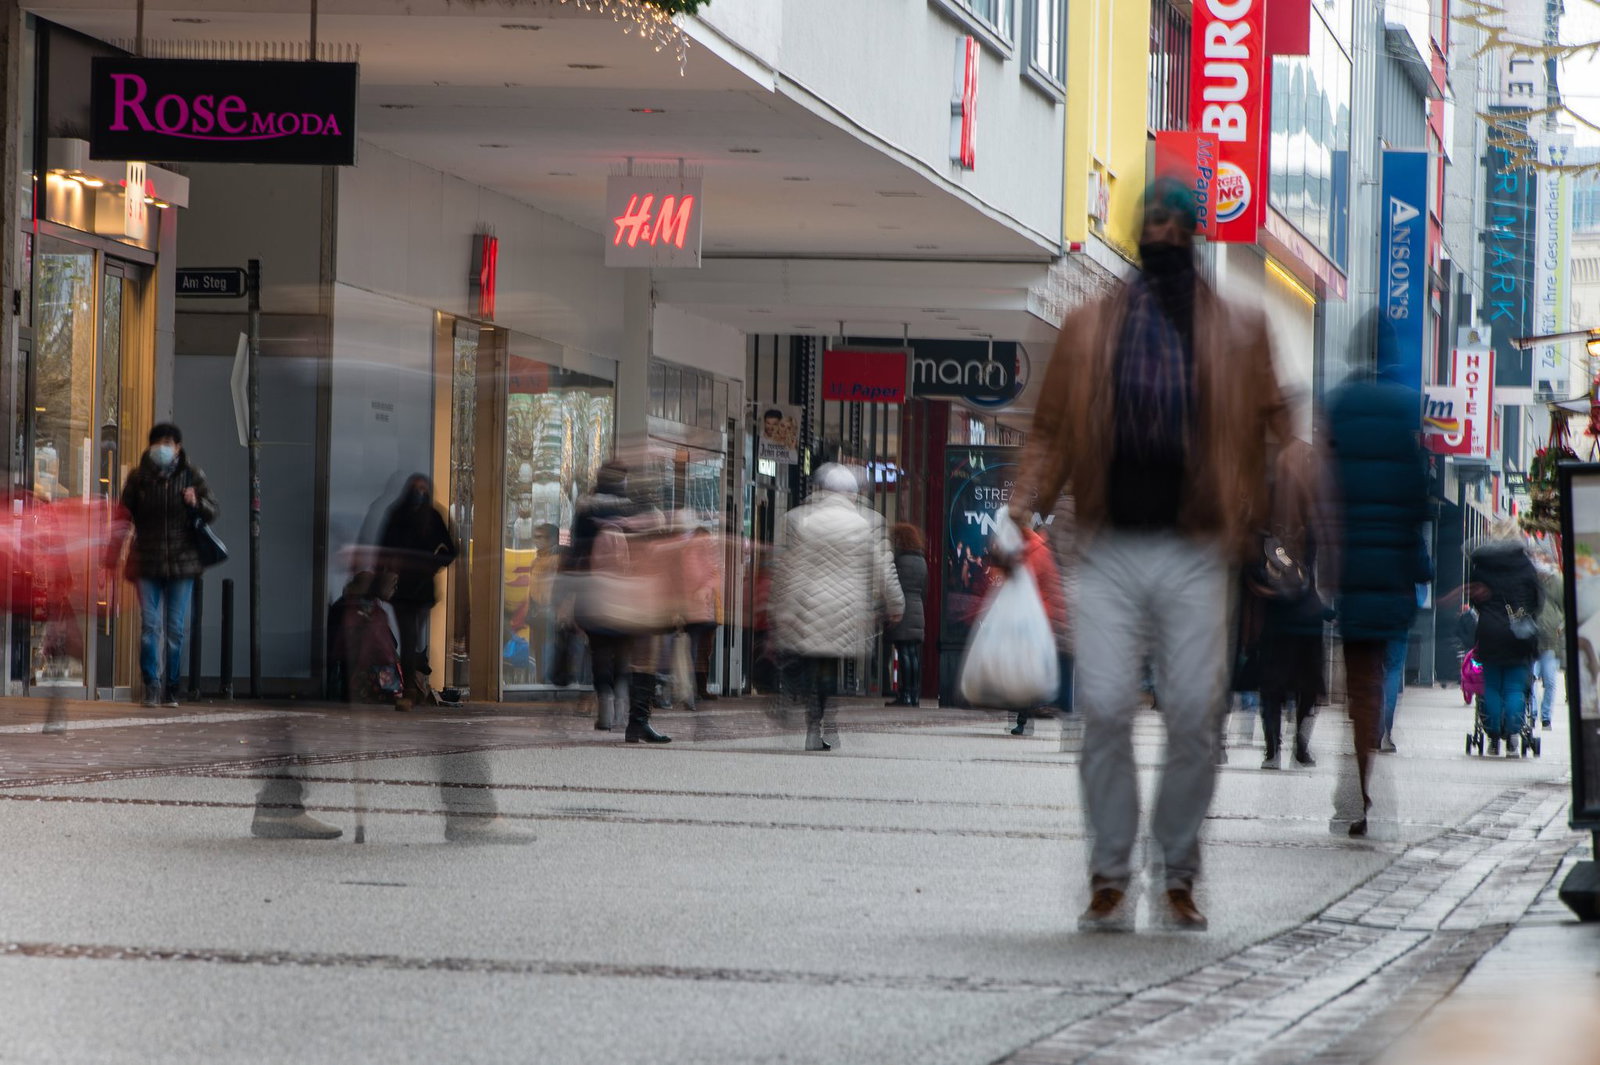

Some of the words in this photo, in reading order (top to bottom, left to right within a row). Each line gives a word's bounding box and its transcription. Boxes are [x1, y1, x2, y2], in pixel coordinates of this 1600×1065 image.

[250, 112, 342, 136] MODA
[613, 193, 695, 249] H&M
[1491, 148, 1518, 322] PRIMARK
[1544, 180, 1560, 270] Gesundheit
[182, 276, 199, 289] Am
[203, 276, 227, 290] Steg
[1544, 276, 1557, 305] Ihre
[1542, 341, 1555, 368] Zei
[1466, 355, 1480, 430] HOTE
